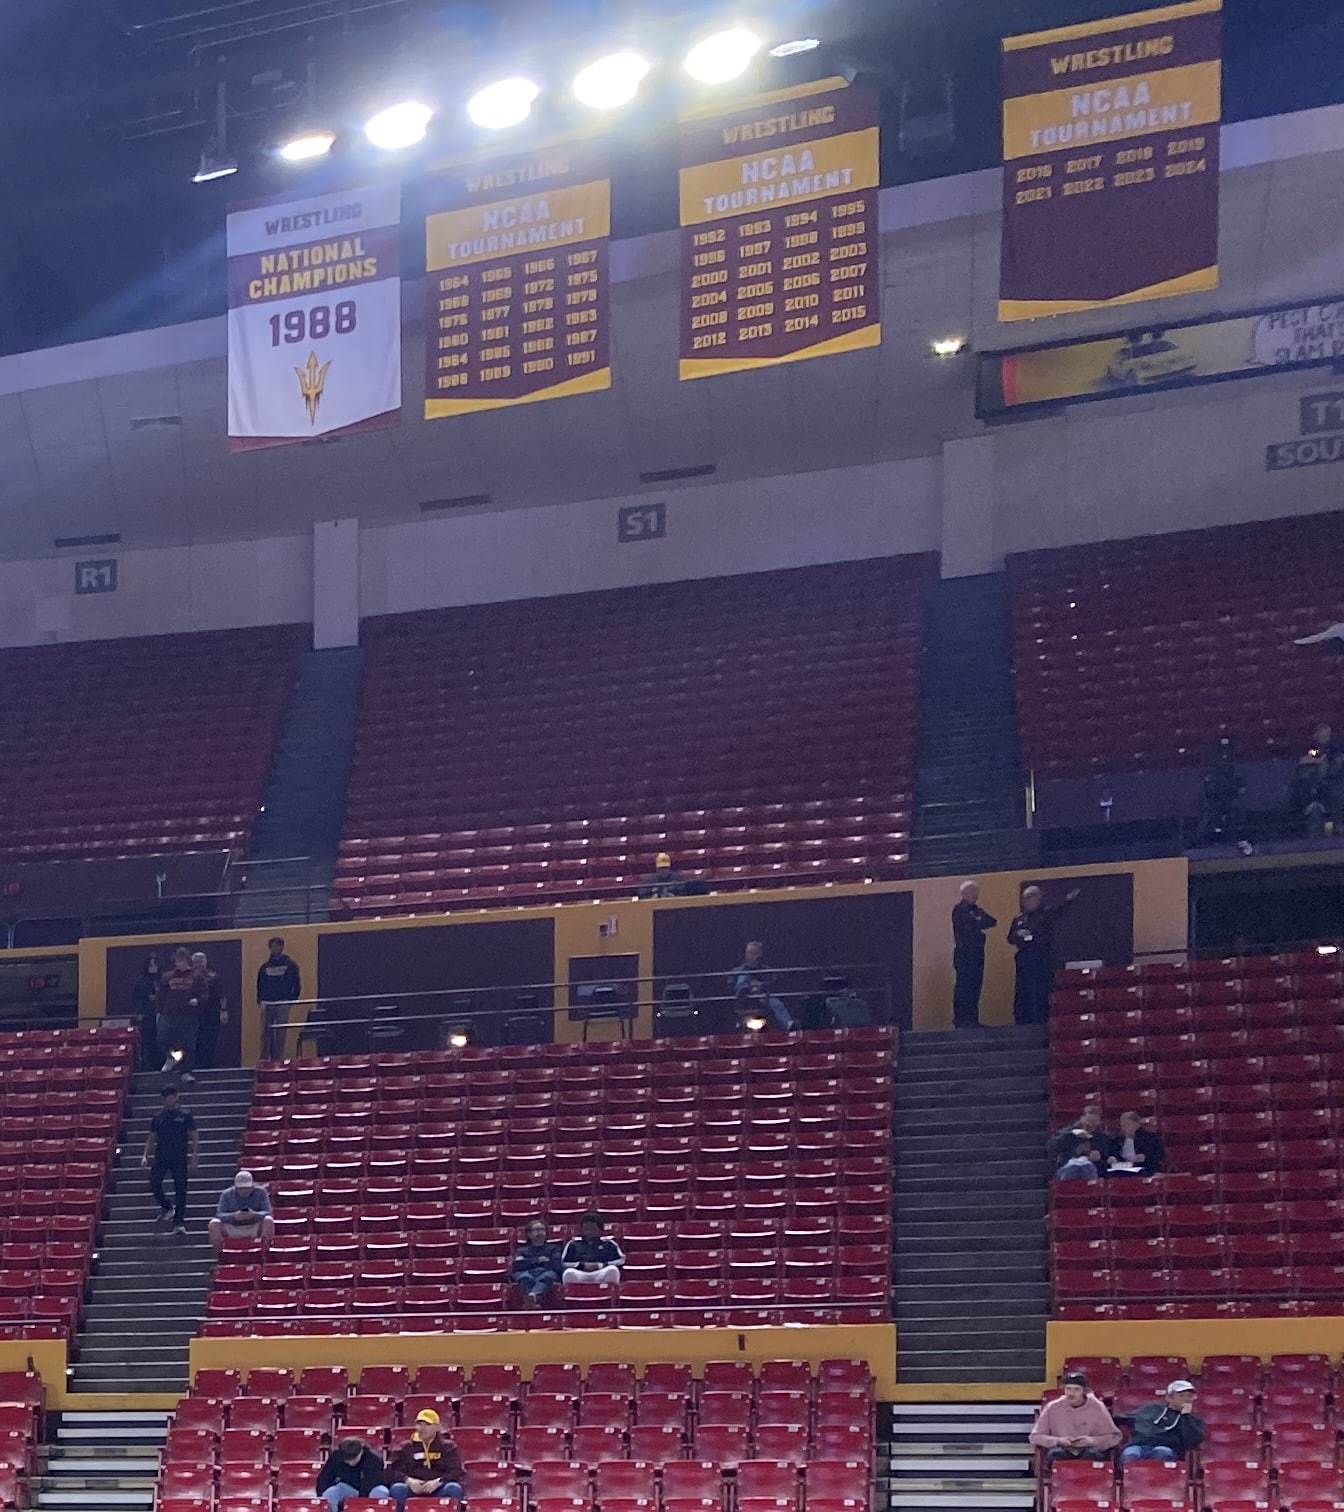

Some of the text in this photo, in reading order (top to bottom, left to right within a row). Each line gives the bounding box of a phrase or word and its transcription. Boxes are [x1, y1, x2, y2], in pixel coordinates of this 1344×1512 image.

[1050, 35, 1174, 75] WRESTLING
[1071, 81, 1151, 118] NCAA
[723, 105, 835, 145] WRESTLING
[1029, 101, 1192, 148] TOURNAMENT
[742, 149, 815, 185] NCAA
[704, 168, 854, 214] TOURNAMENT
[265, 203, 362, 236] WRESTLING
[483, 199, 551, 232] NCAA
[261, 237, 366, 274] NATIONAL
[447, 217, 586, 260] TOURNAMENT
[248, 257, 377, 299] CHAMPIONS
[269, 300, 357, 347] 1988
[627, 511, 658, 536] S1
[82, 566, 111, 588] R1
